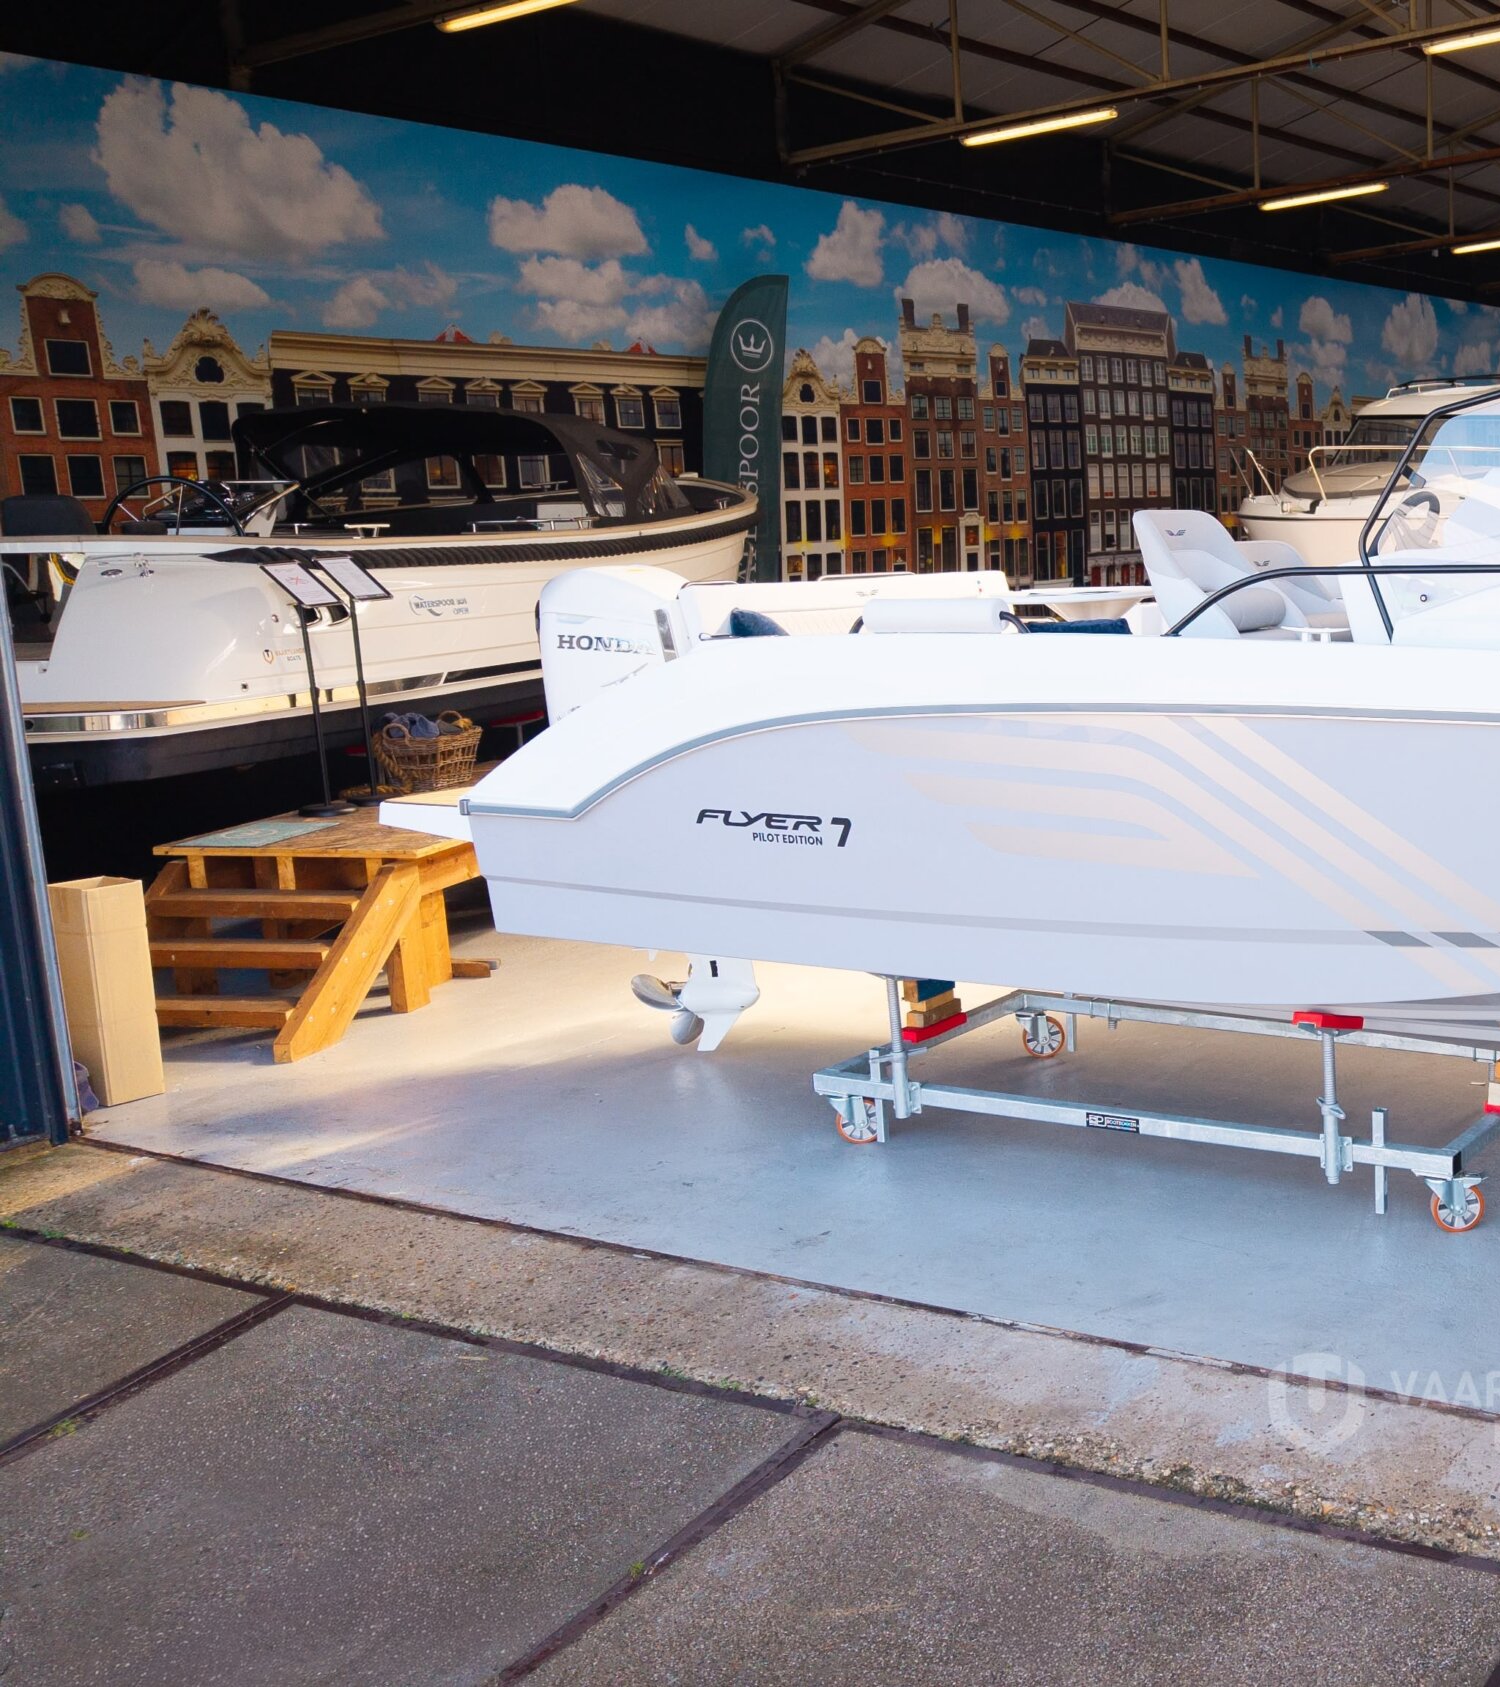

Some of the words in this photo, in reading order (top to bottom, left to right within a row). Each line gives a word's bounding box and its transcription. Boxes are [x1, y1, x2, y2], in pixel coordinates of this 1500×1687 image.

[696, 808, 822, 833] FLYER
[830, 816, 852, 848] 7
[752, 832, 780, 844] PILOT
[783, 834, 823, 846] EDITION
